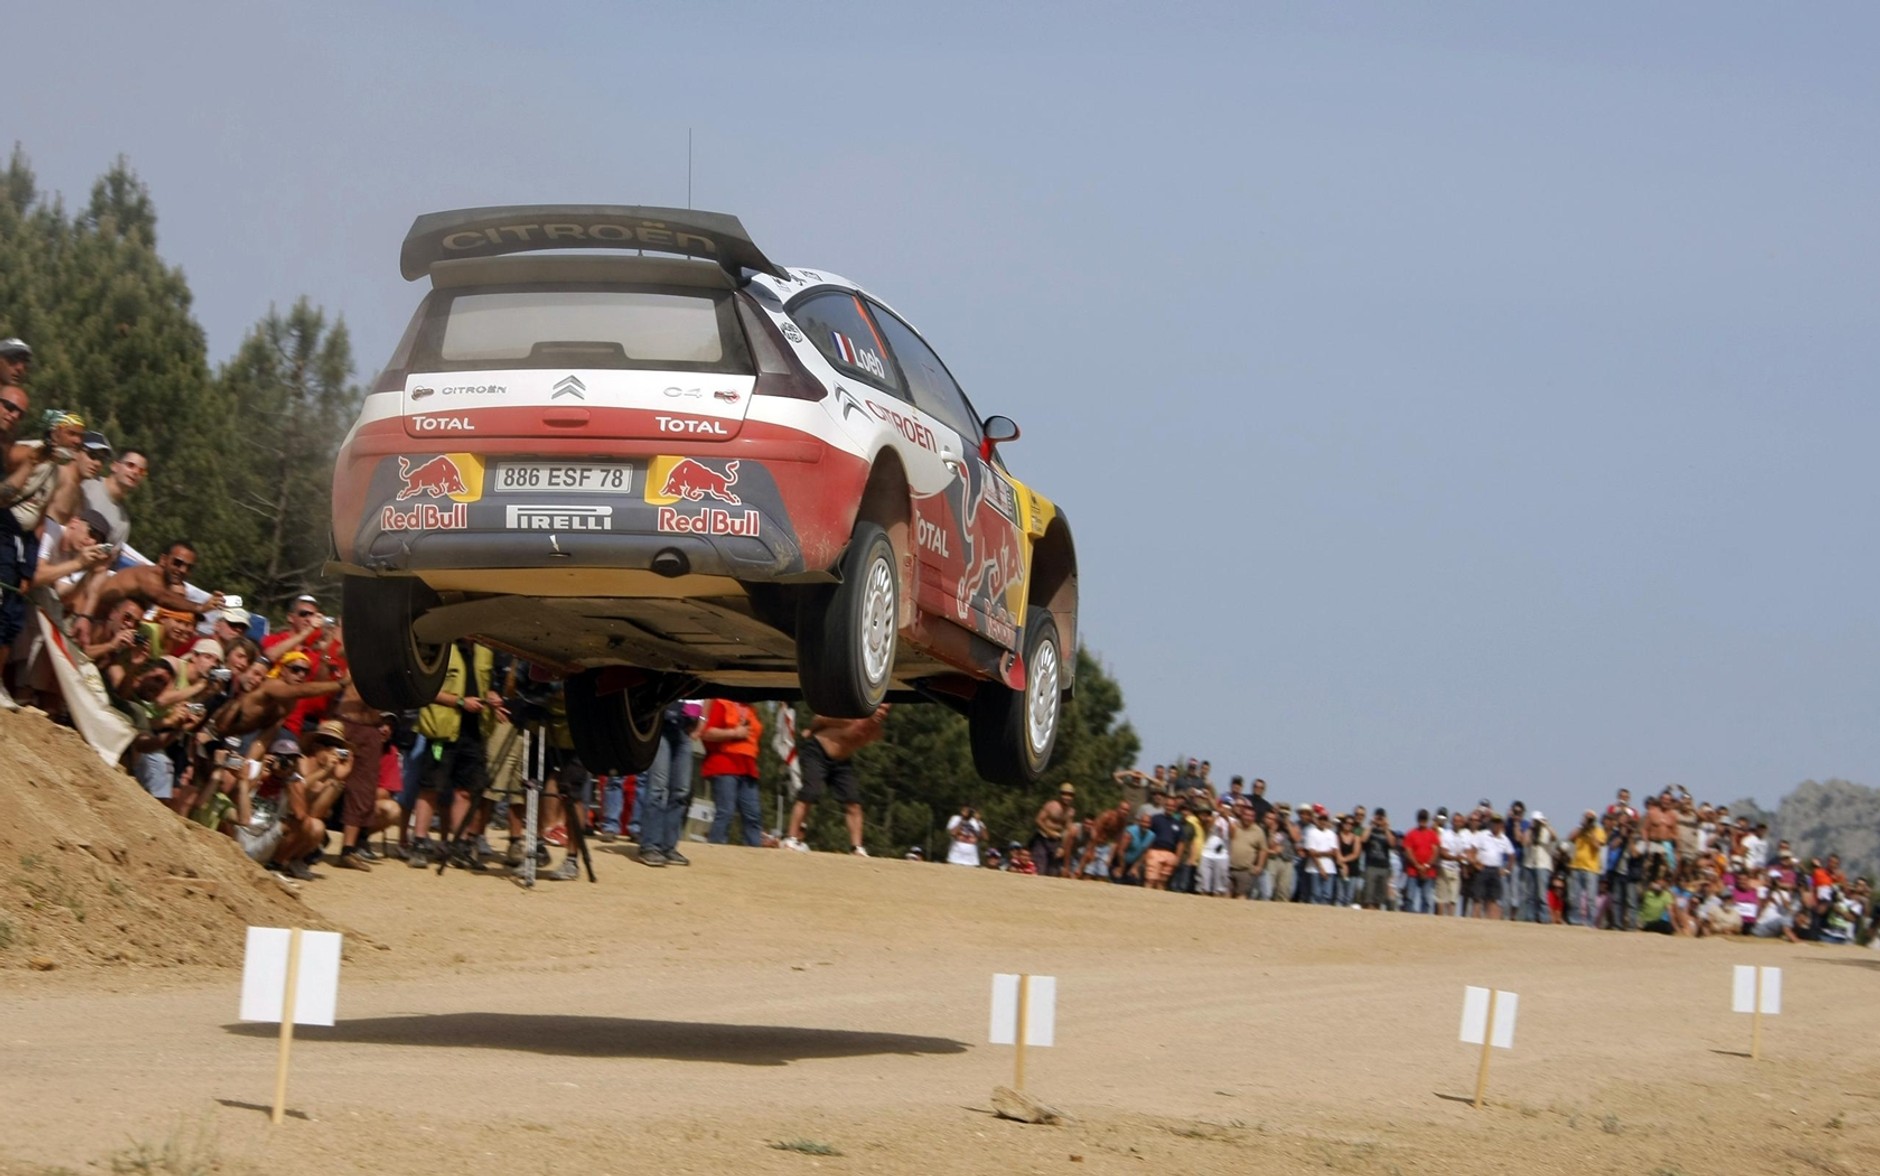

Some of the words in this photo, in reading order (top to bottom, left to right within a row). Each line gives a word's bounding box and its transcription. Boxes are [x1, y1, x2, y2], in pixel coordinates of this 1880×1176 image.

[847, 337, 885, 379] Loeb
[412, 416, 475, 431] TOTAL
[655, 416, 728, 435] TOTAL
[503, 467, 540, 487] 886
[547, 467, 593, 487] ESF
[600, 468, 624, 488] 78
[506, 504, 613, 530] PIRELLI
